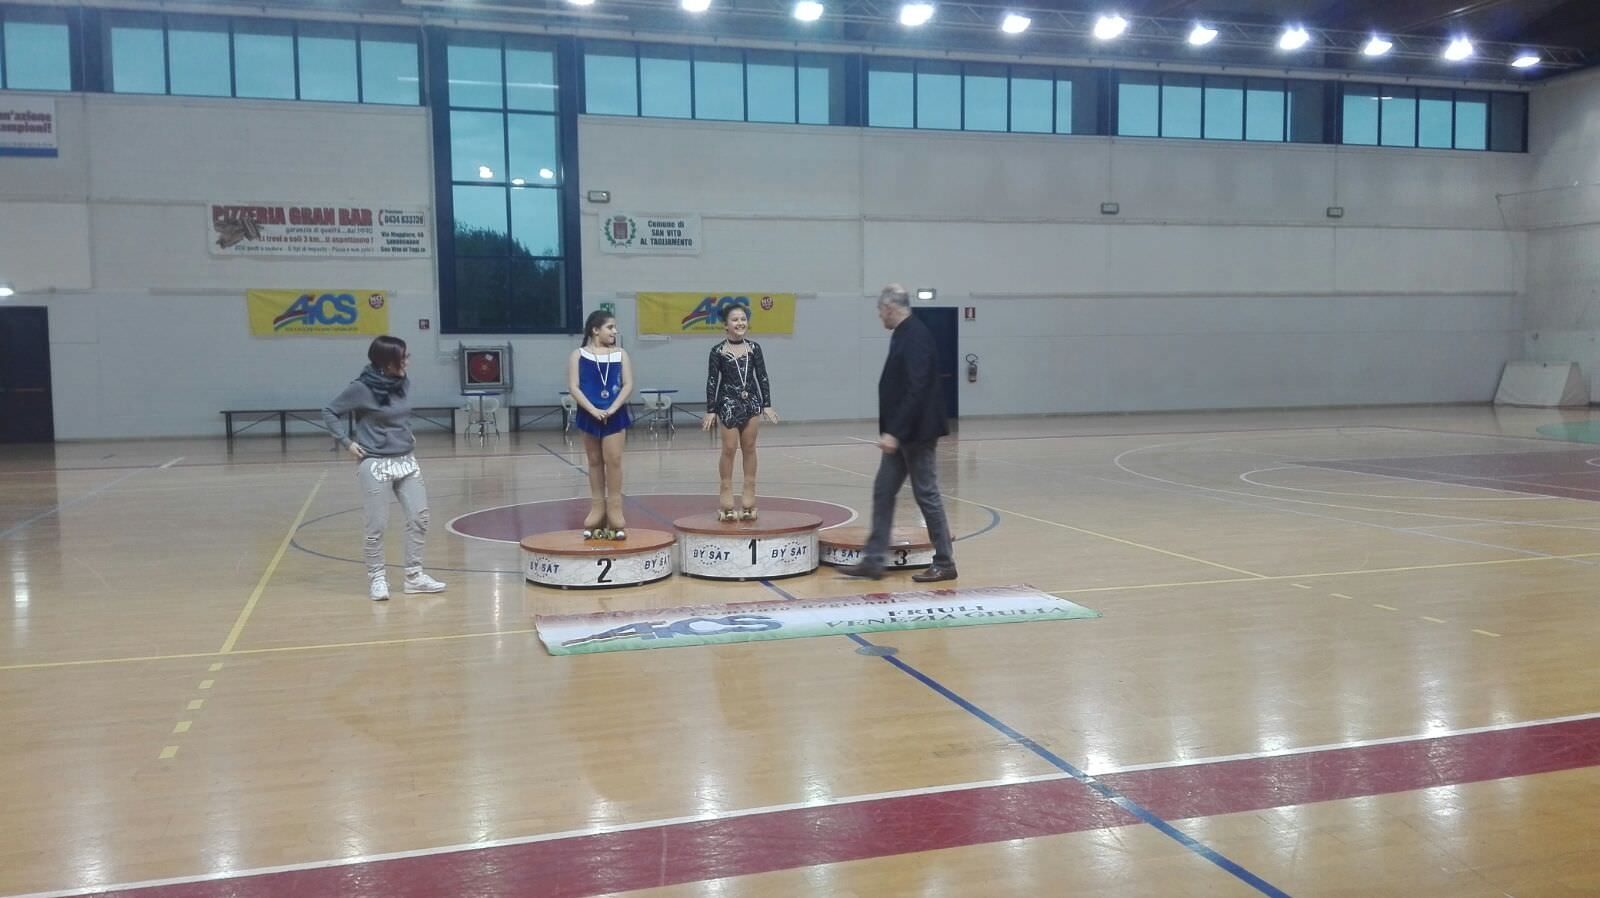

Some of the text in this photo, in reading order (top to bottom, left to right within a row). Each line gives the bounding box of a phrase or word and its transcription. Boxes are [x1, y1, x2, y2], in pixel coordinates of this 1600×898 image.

[0, 122, 52, 134] ampioni!
[213, 206, 373, 227] PIZZERIA GRAN BAR
[648, 220, 685, 229] Comune di
[651, 229, 682, 237] SAN VITO
[640, 238, 693, 247] AL TAGLIAMENTO
[709, 550, 731, 561] SAT
[771, 546, 808, 559] BY SAT
[841, 548, 861, 558] SAT
[541, 563, 560, 574] SAT
[644, 558, 657, 570] BY
[825, 605, 1069, 628] VENEZIA GIULIA
[888, 605, 984, 618] FRIULI
